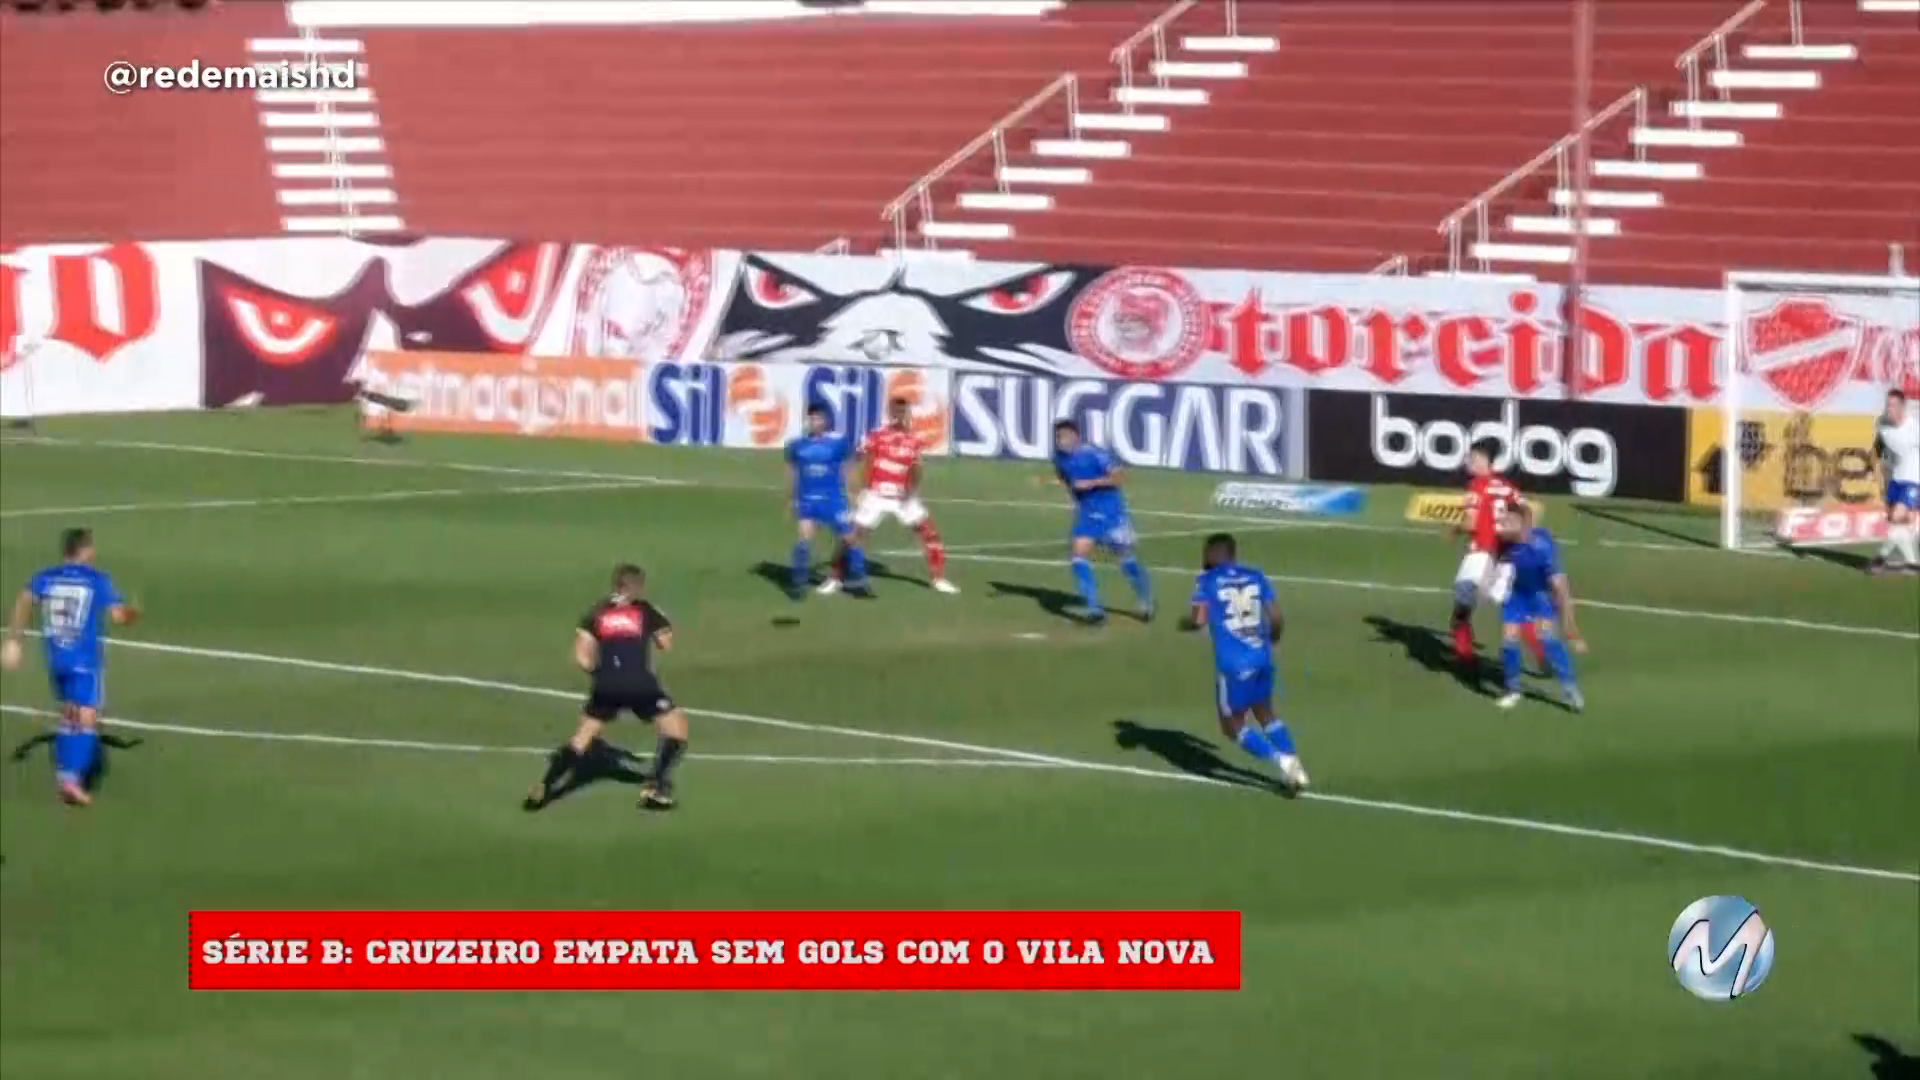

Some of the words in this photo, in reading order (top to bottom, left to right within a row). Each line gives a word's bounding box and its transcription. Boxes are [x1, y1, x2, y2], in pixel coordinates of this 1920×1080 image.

[1222, 290, 1727, 402] torcida
[651, 362, 724, 443] Sil
[957, 373, 1282, 474] SUGGAR
[1371, 392, 1618, 497] bodog
